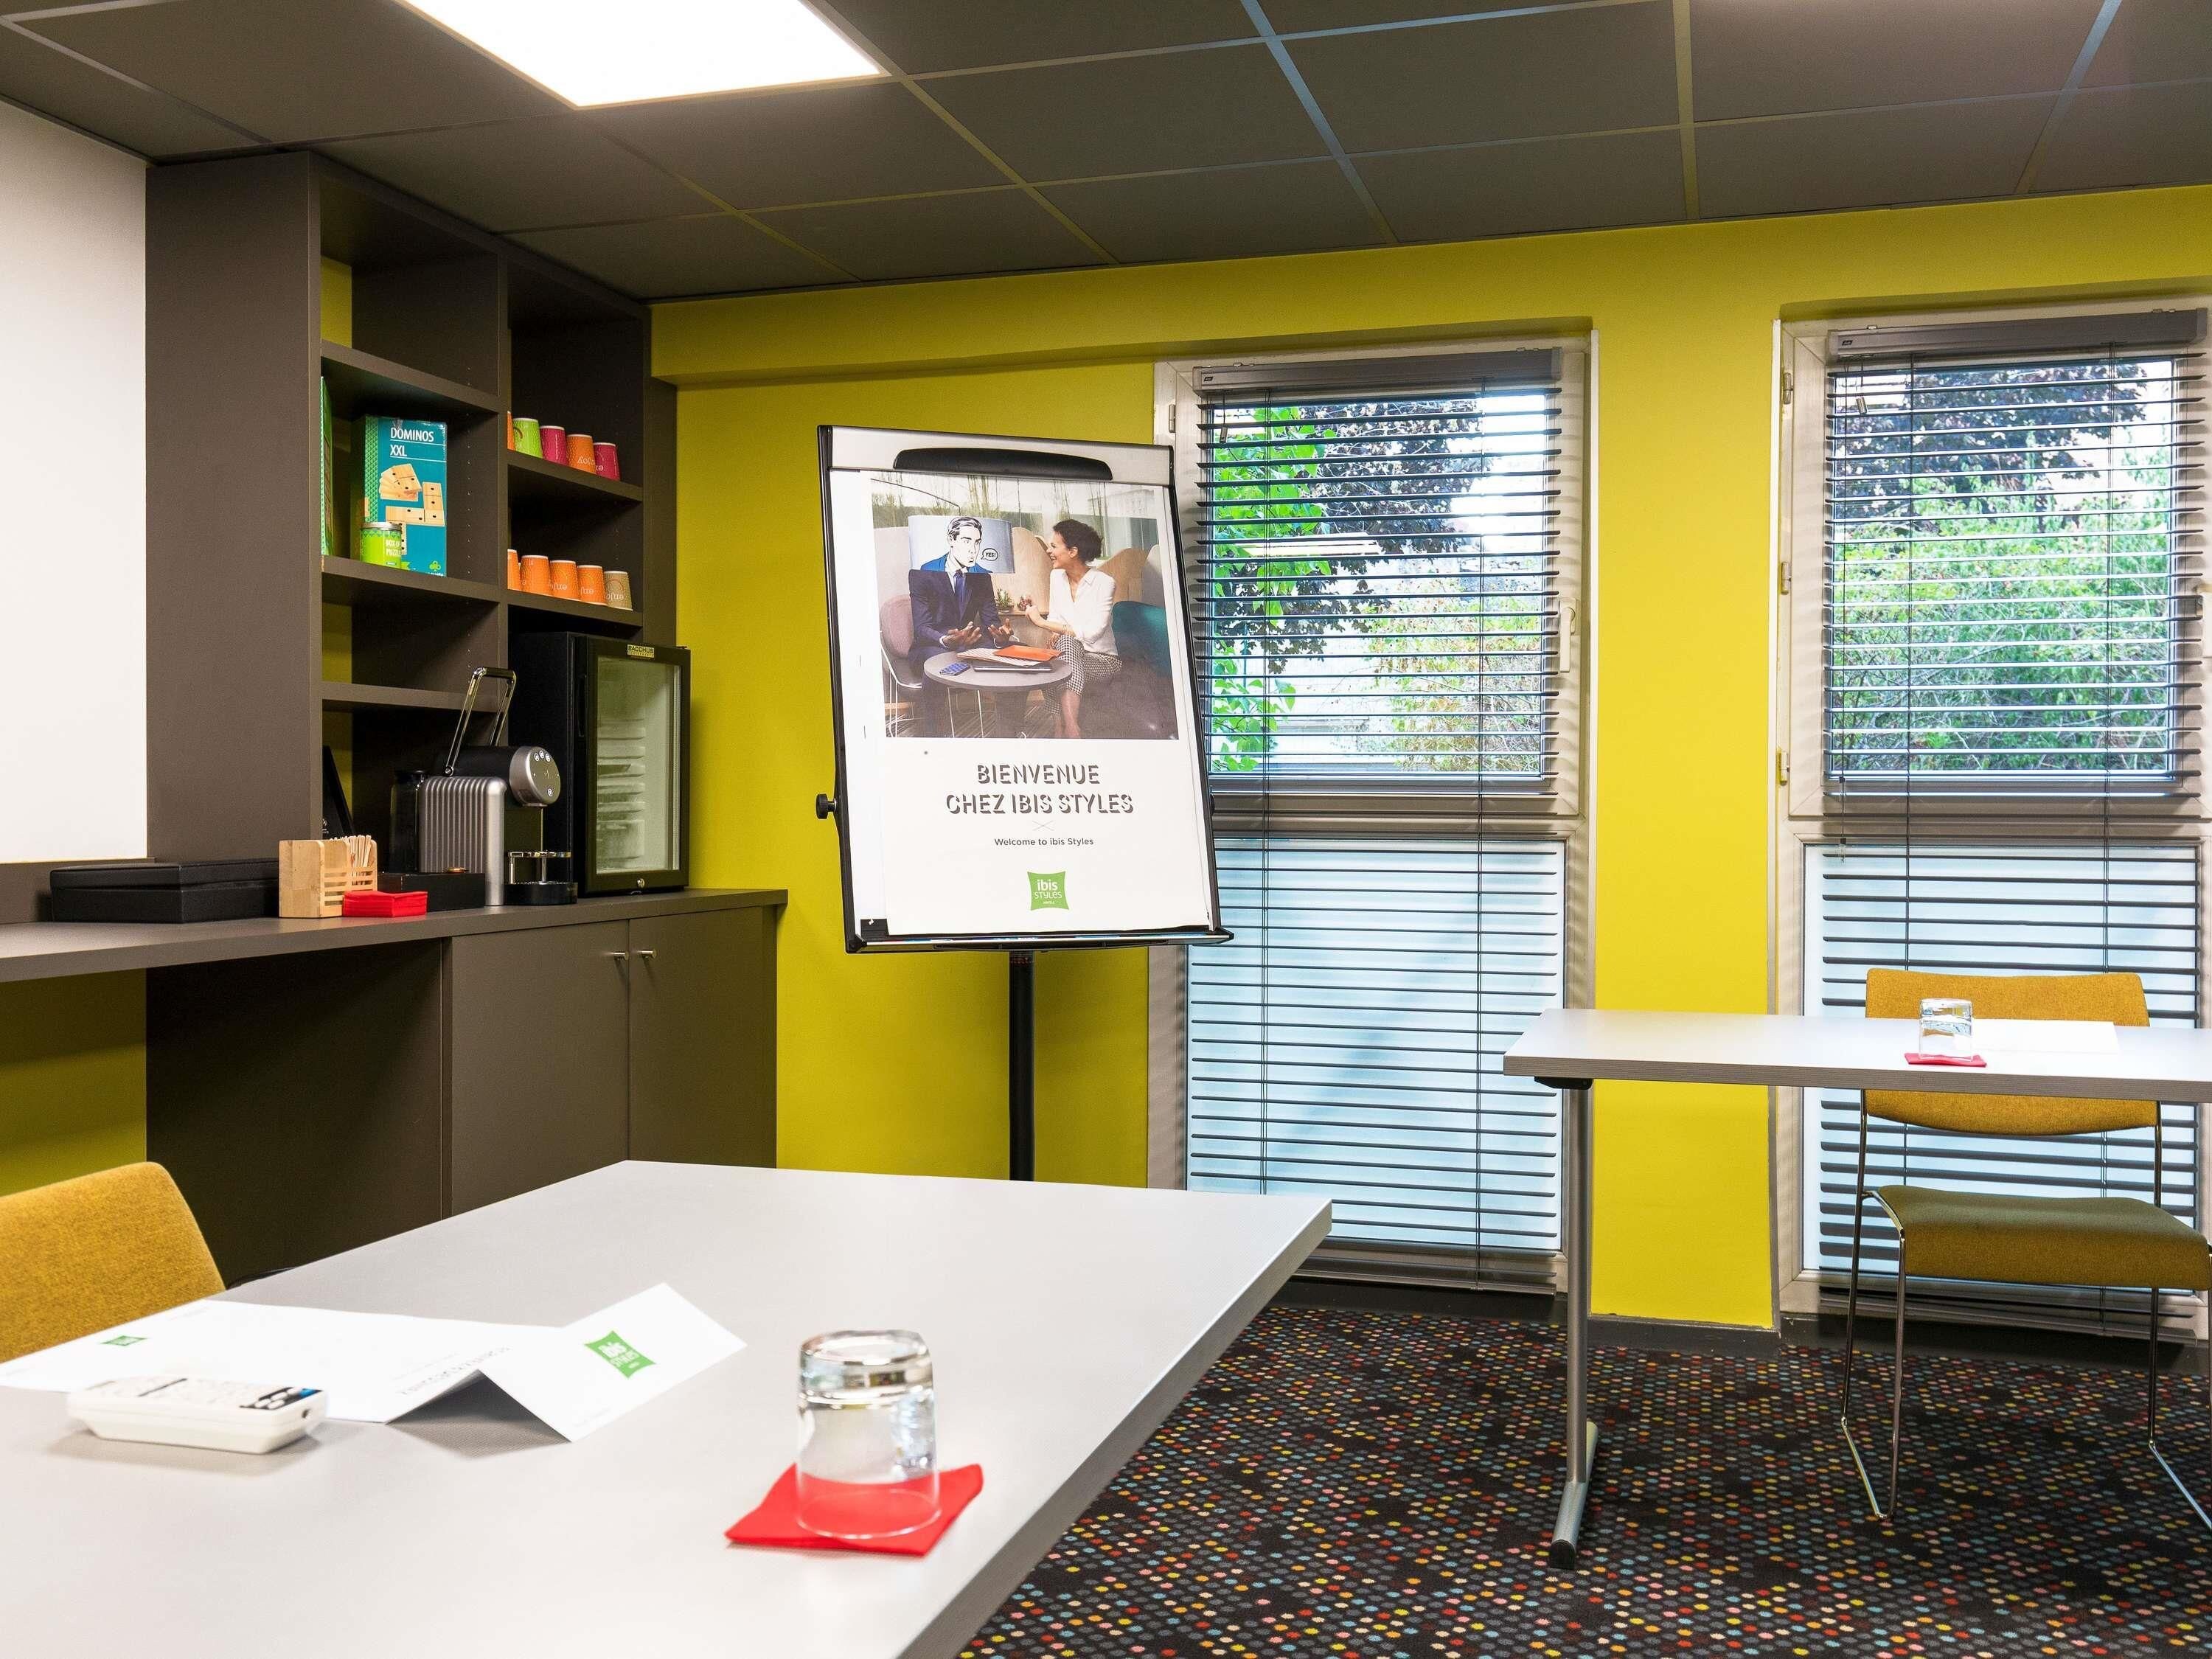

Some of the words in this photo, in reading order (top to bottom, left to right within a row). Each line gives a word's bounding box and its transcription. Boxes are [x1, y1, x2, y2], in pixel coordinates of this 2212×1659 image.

[391, 427, 434, 442] DOMINOS
[390, 444, 408, 457] XXL
[628, 645, 654, 654] BACCHUS
[977, 764, 1101, 785] BIENVENUE
[946, 793, 1006, 814] CHEZ
[1012, 793, 1053, 814] IBIS
[1058, 793, 1134, 814] STYLES
[994, 838, 1036, 846] Welcome
[1050, 838, 1065, 846] ibis
[1067, 838, 1093, 846] Styles
[1037, 878, 1058, 891] ibis
